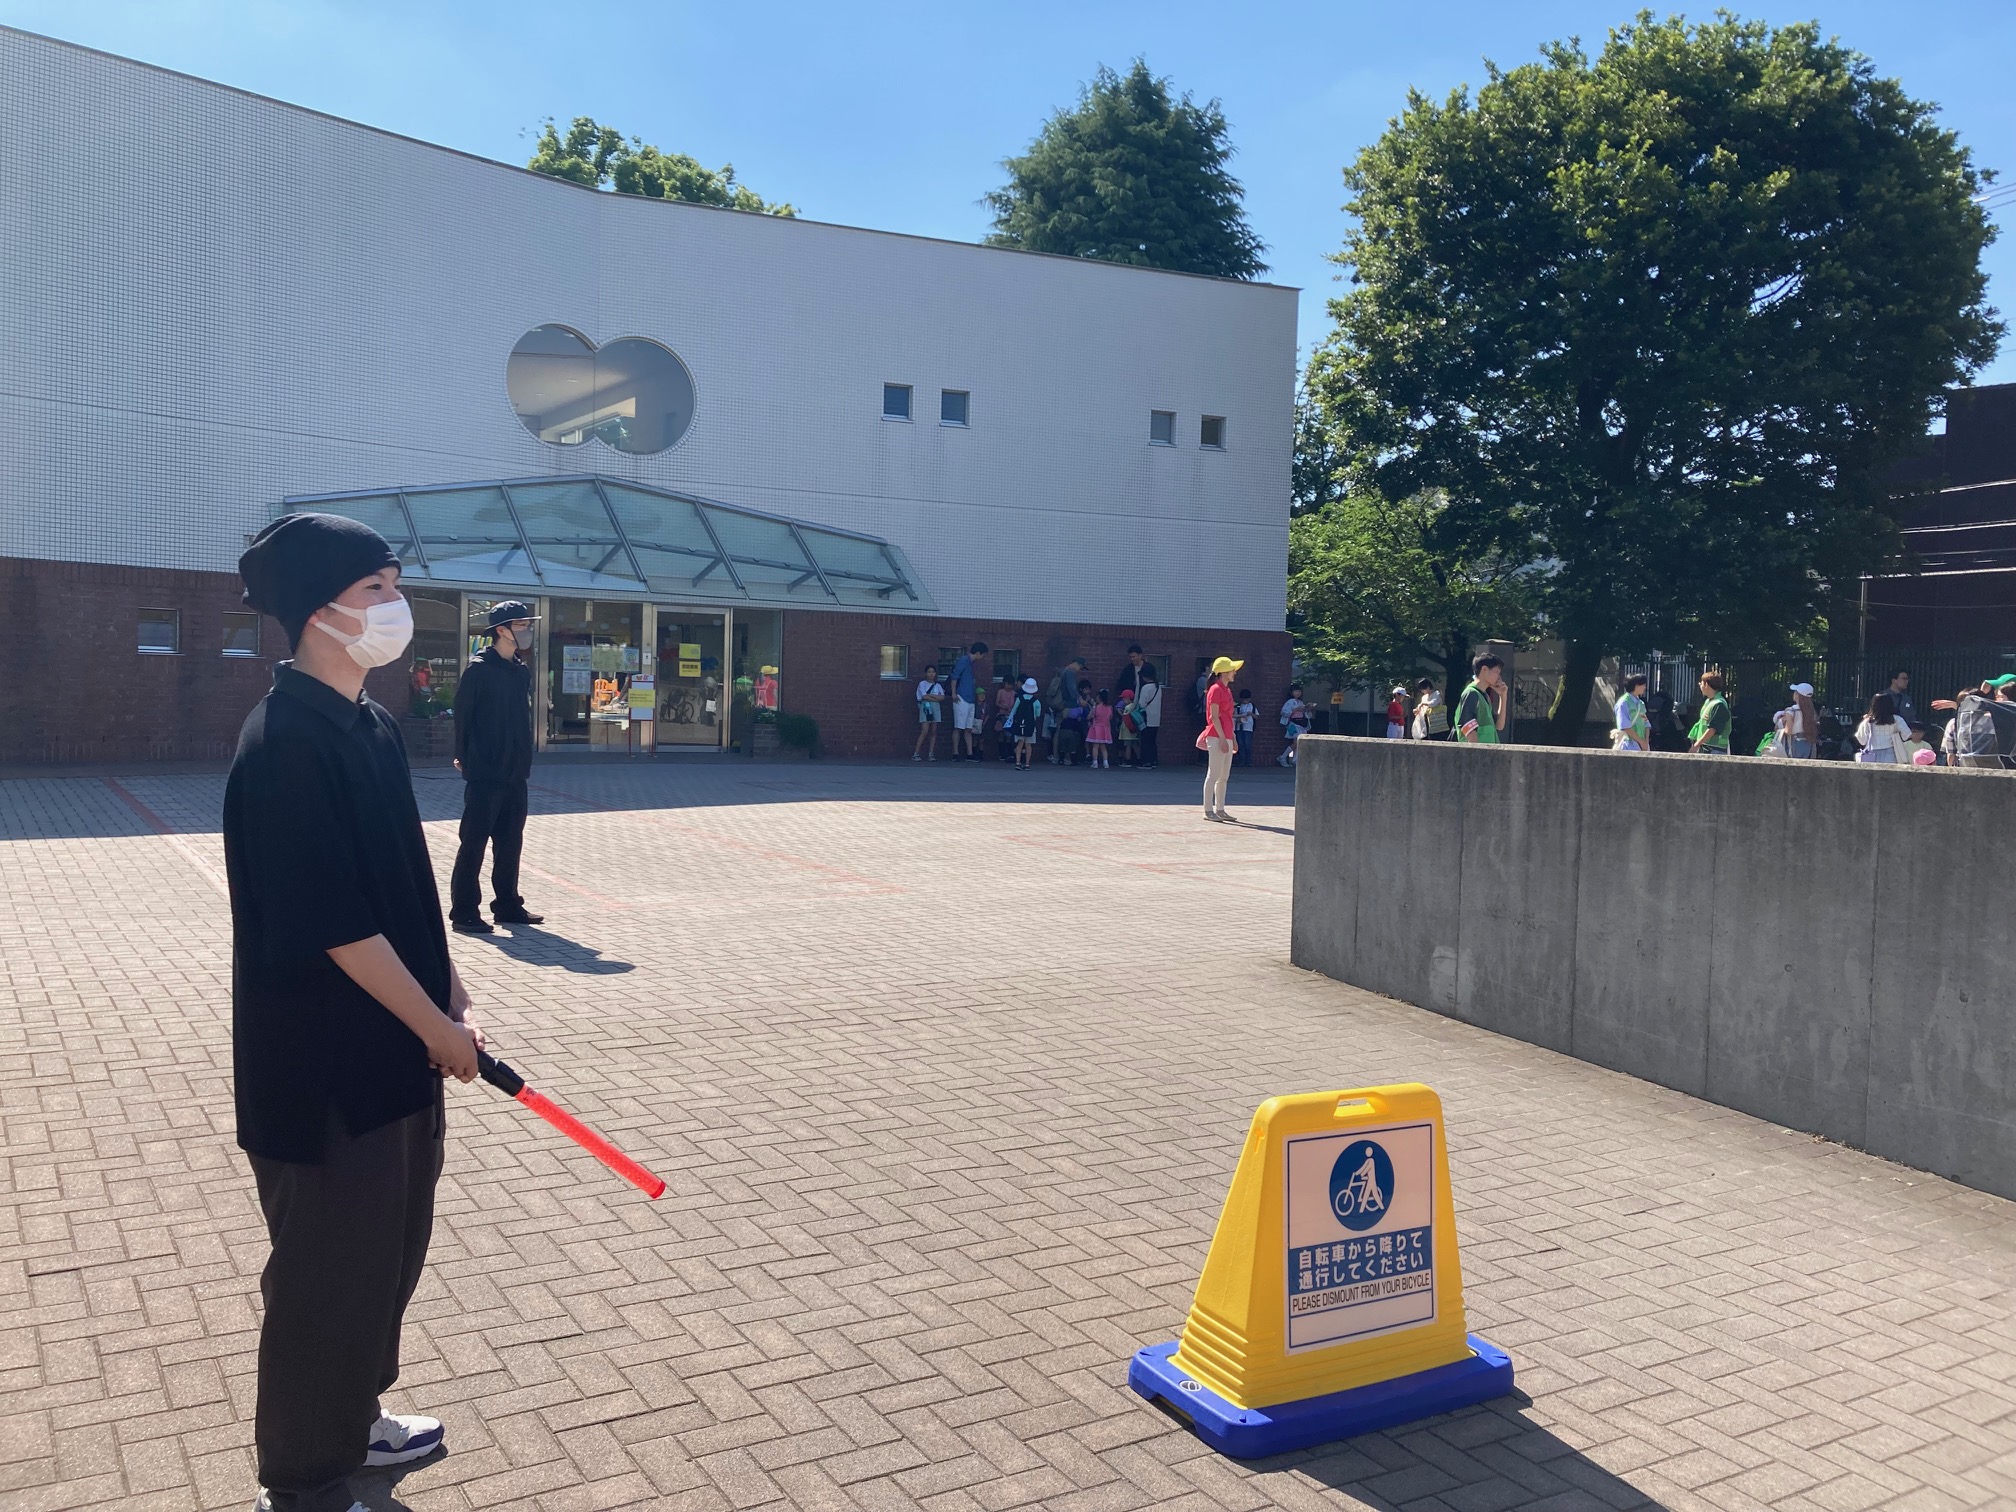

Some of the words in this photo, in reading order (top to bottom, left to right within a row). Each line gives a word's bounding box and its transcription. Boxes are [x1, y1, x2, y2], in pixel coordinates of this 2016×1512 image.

[1299, 1231, 1423, 1269] 自転車から降りて
[1299, 1252, 1423, 1290] 通行してください
[1292, 1294, 1321, 1312] PLEASE
[1322, 1286, 1360, 1306] DISMOUNT
[1361, 1283, 1381, 1298] FROM
[1382, 1279, 1402, 1294] YOUR
[1402, 1273, 1430, 1289] BICYCLE
